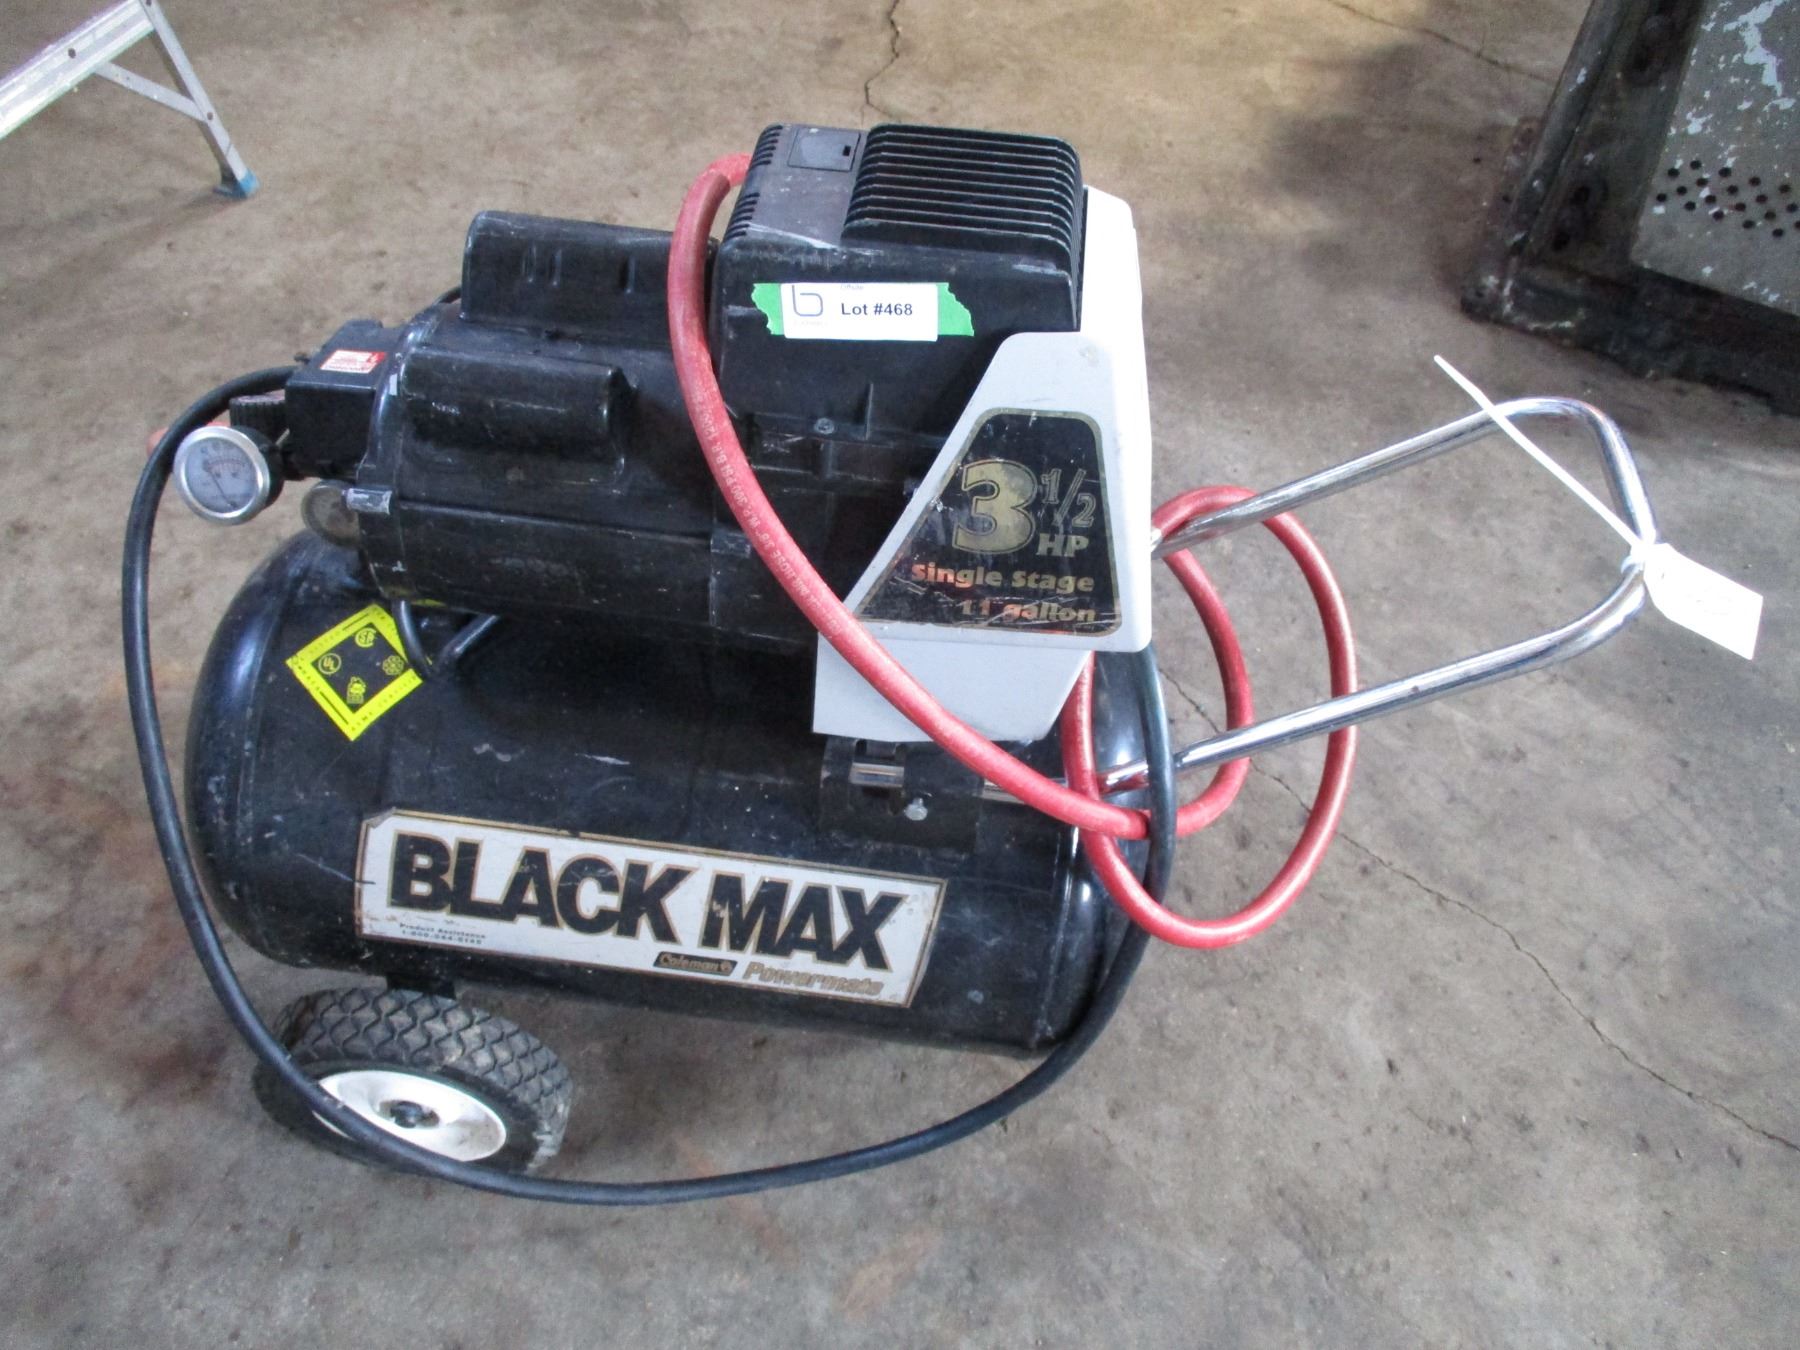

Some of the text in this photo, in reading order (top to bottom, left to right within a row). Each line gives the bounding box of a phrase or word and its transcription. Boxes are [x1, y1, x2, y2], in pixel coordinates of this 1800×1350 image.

[841, 303, 914, 316] Lot #468
[718, 463, 739, 486] PSI
[729, 483, 749, 507] 300
[952, 458, 1039, 555] 3
[1036, 534, 1090, 558] HP
[768, 548, 797, 580] HOSE
[911, 561, 1095, 594] single stage
[1002, 601, 1096, 622] gallon
[387, 829, 910, 973] BLACK MAX
[659, 954, 885, 997] Coleman Powermate
